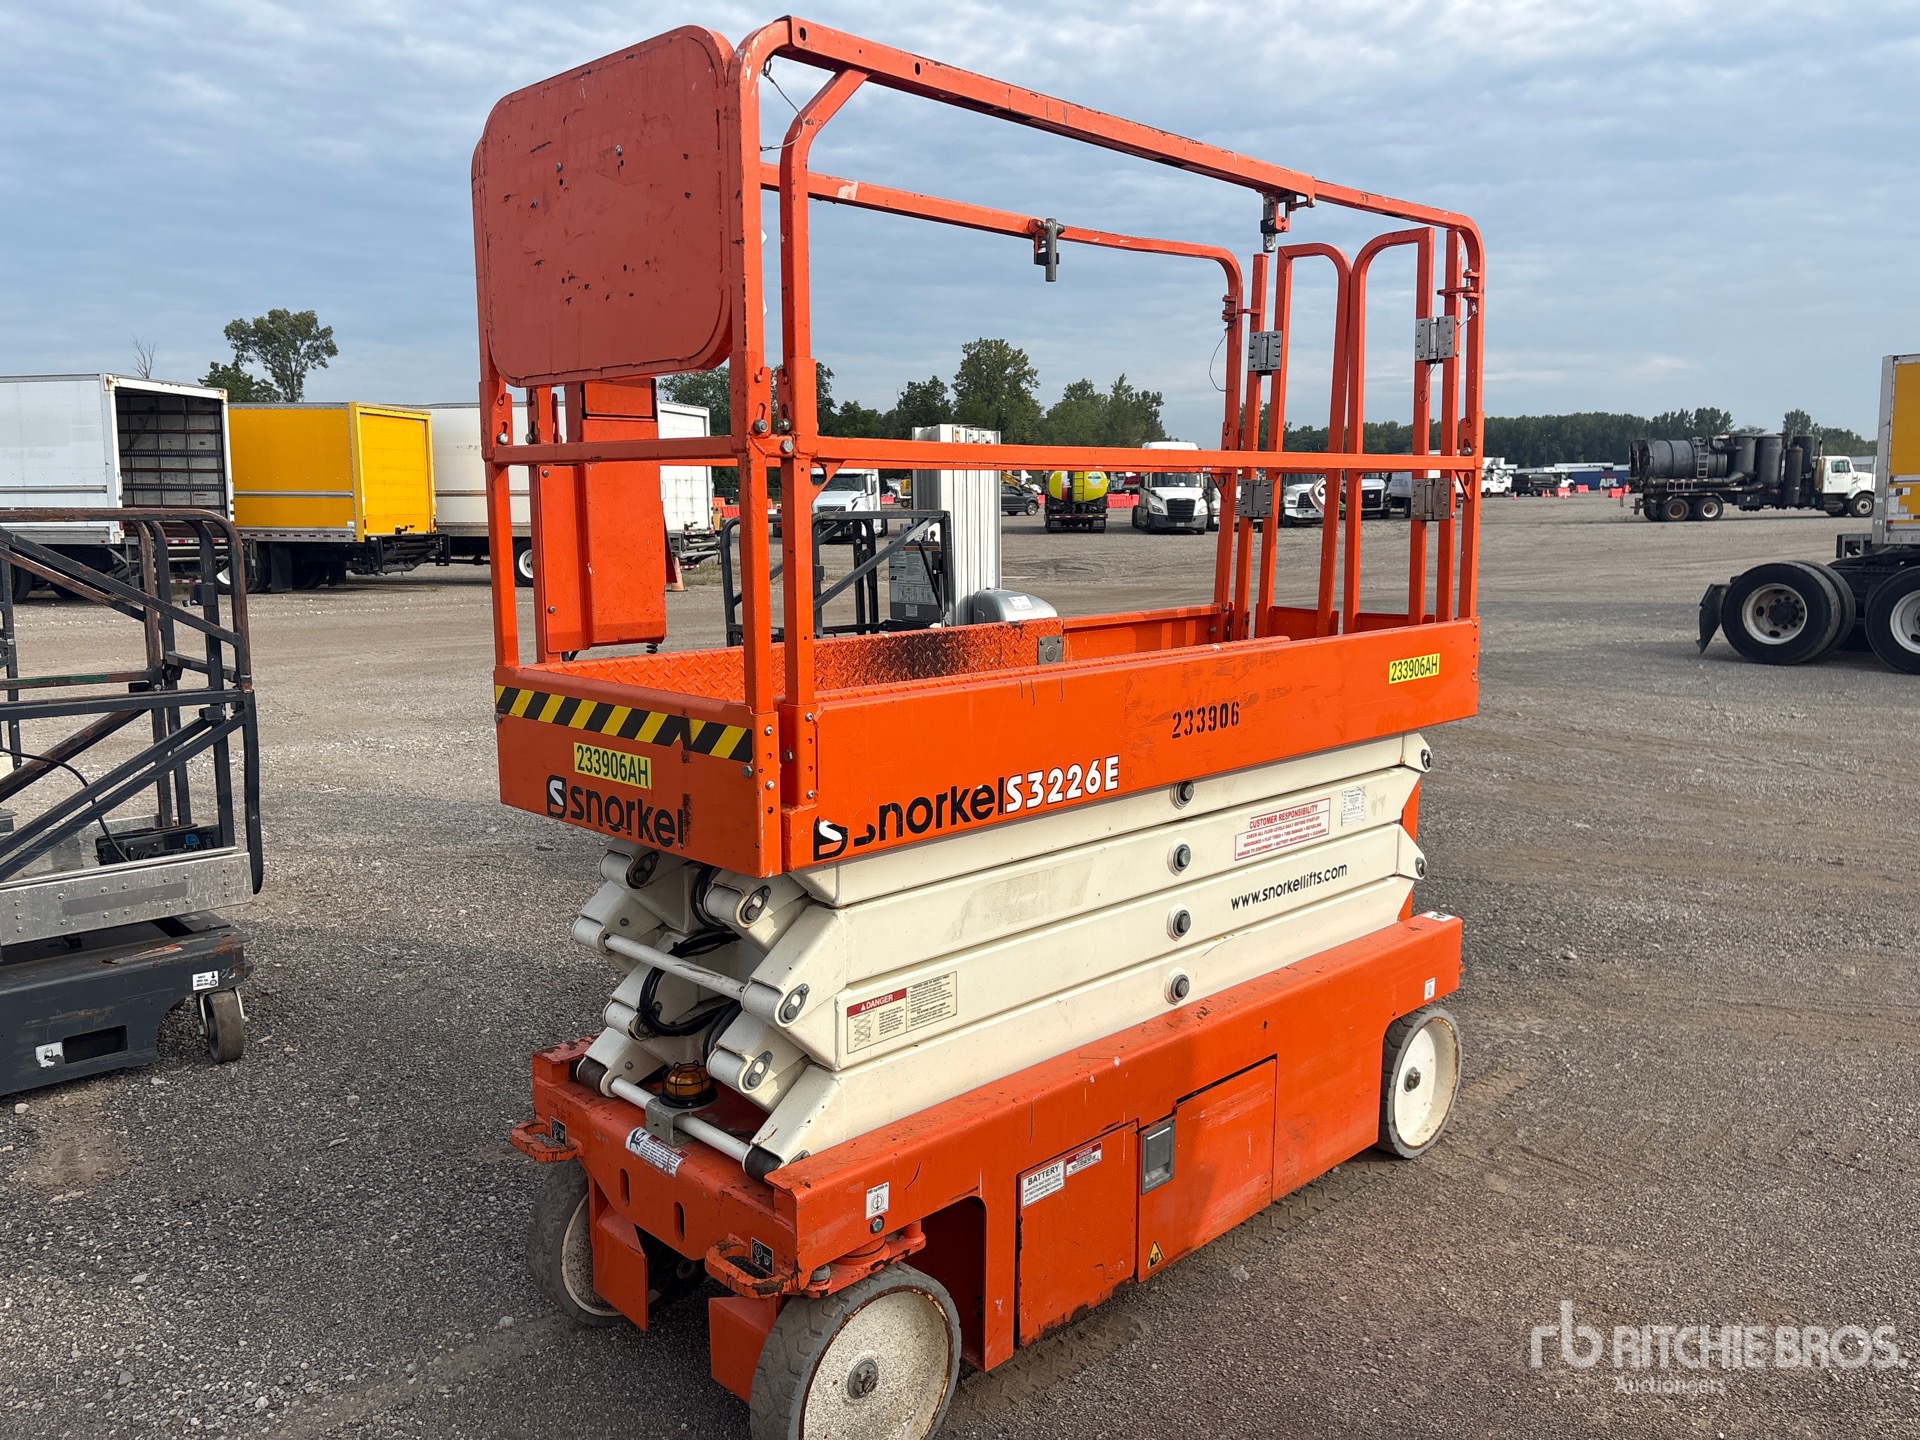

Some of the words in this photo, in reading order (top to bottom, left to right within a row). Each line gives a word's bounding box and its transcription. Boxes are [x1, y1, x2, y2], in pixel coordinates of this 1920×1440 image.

[1599, 478, 1619, 487] APL
[1391, 655, 1438, 681] 233906AH
[1172, 701, 1240, 739] 233906
[577, 745, 649, 787] 233906AH
[1005, 755, 1120, 813] S3226E
[570, 786, 684, 849] snorkel
[1250, 815, 1277, 829] CUSTOMER
[1279, 804, 1318, 821] RESPONSIBILITY
[1231, 863, 1347, 910] www.snorkellifts.com
[866, 994, 894, 1009] DANGER
[1028, 1164, 1060, 1185] BATTERY
